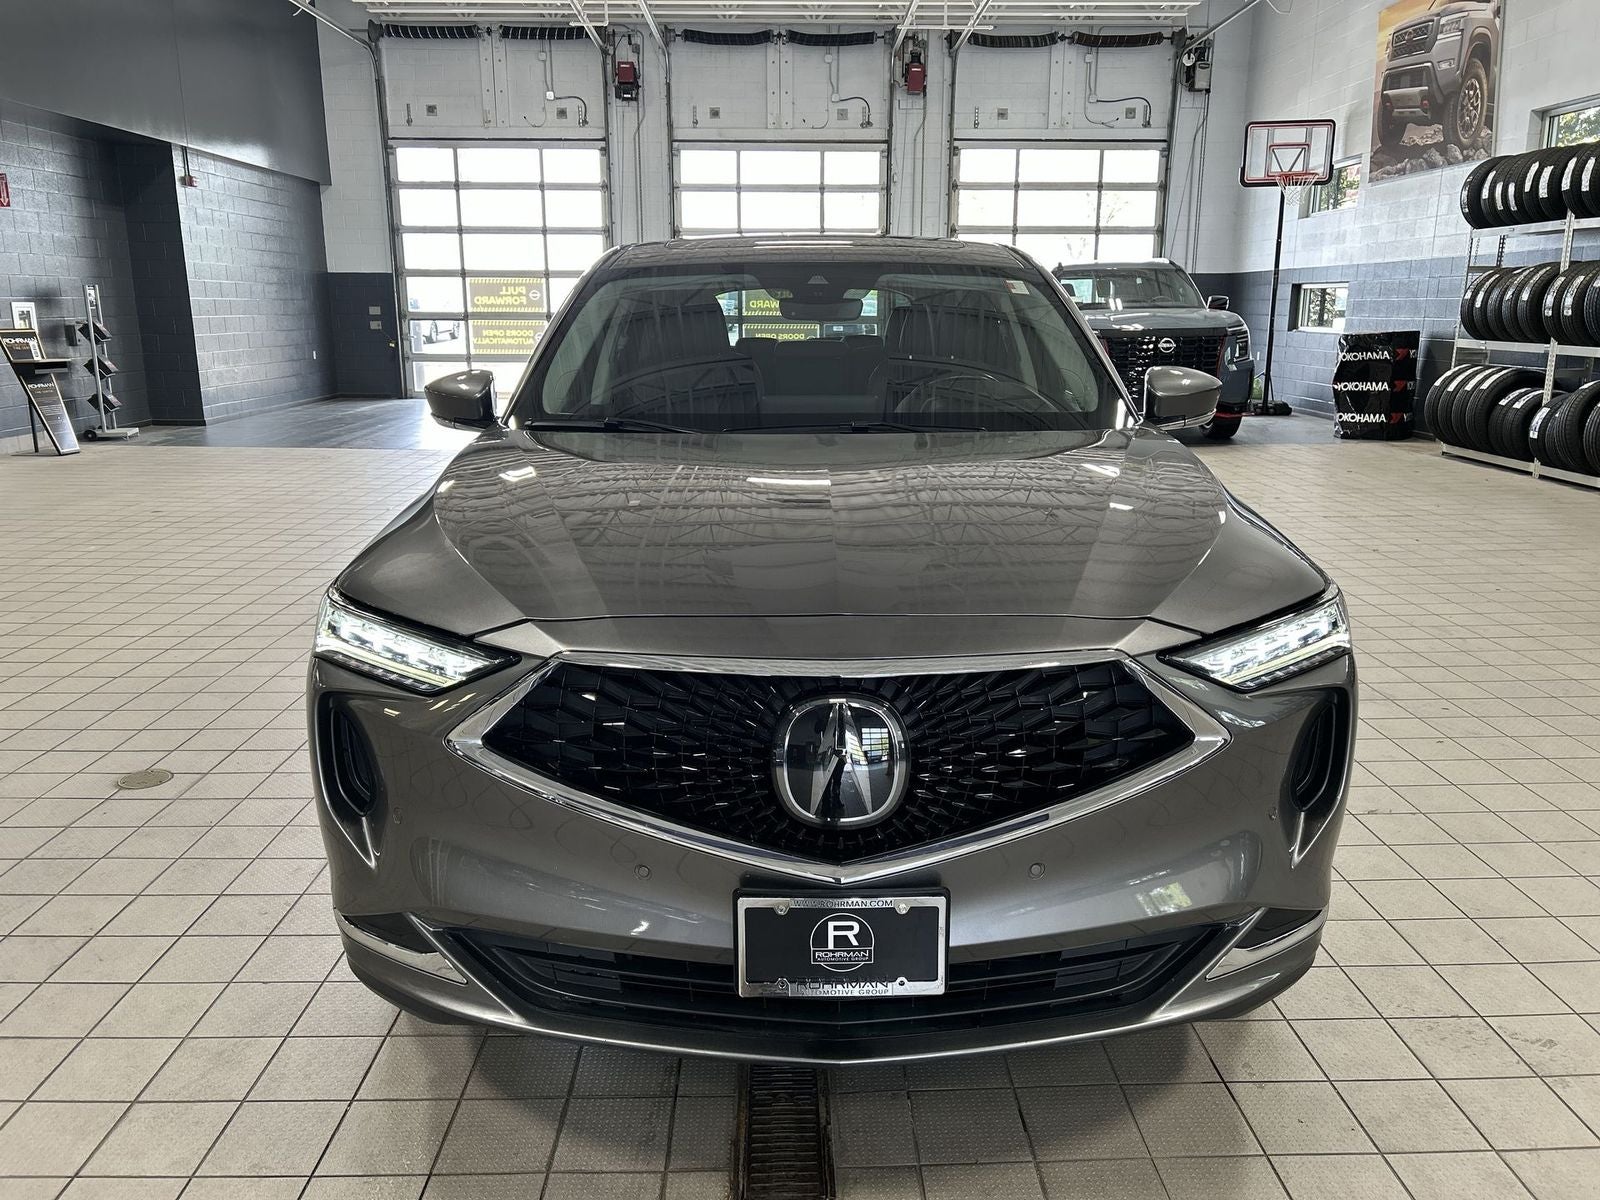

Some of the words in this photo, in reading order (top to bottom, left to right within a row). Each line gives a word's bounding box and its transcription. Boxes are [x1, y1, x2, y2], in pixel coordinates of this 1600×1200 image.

[1336, 381, 1389, 391] YOKOHAMA
[1337, 413, 1387, 423] OKOHAMA
[793, 900, 893, 908] WWW.ROHRMAN.COM
[827, 921, 860, 949] R
[815, 950, 869, 959] ROHRMAN
